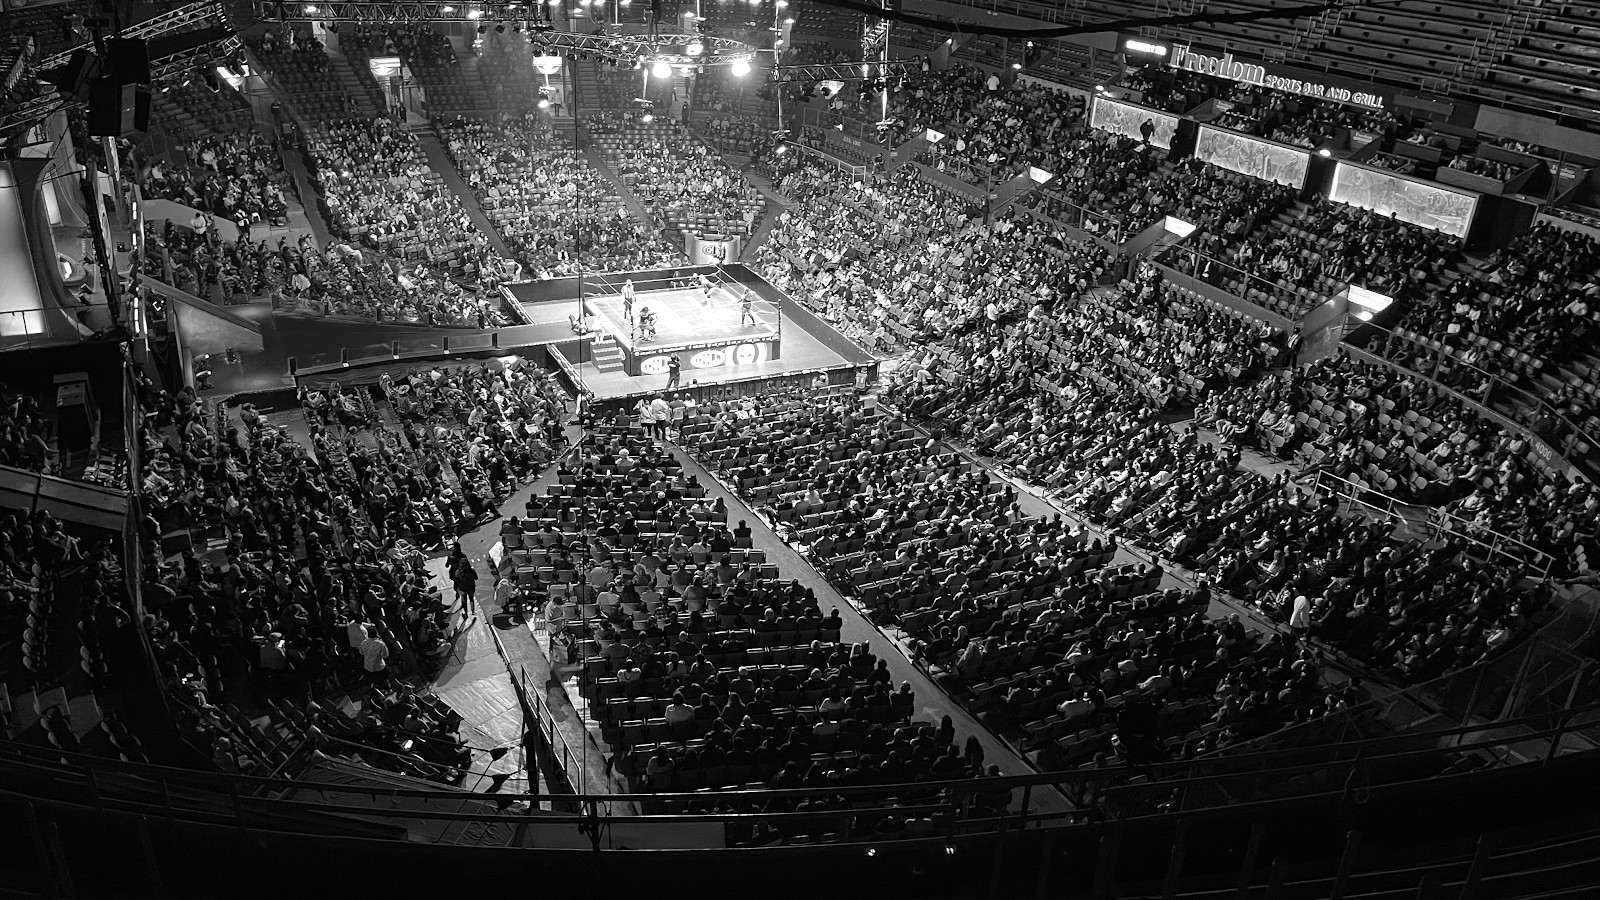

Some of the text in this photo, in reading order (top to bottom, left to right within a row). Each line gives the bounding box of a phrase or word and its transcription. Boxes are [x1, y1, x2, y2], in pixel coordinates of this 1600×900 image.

[1169, 43, 1266, 86] Freedom
[1265, 75, 1302, 92] SPORTS
[1303, 82, 1325, 96] BAR
[1325, 87, 1351, 101] AND
[1352, 92, 1384, 108] GRILL
